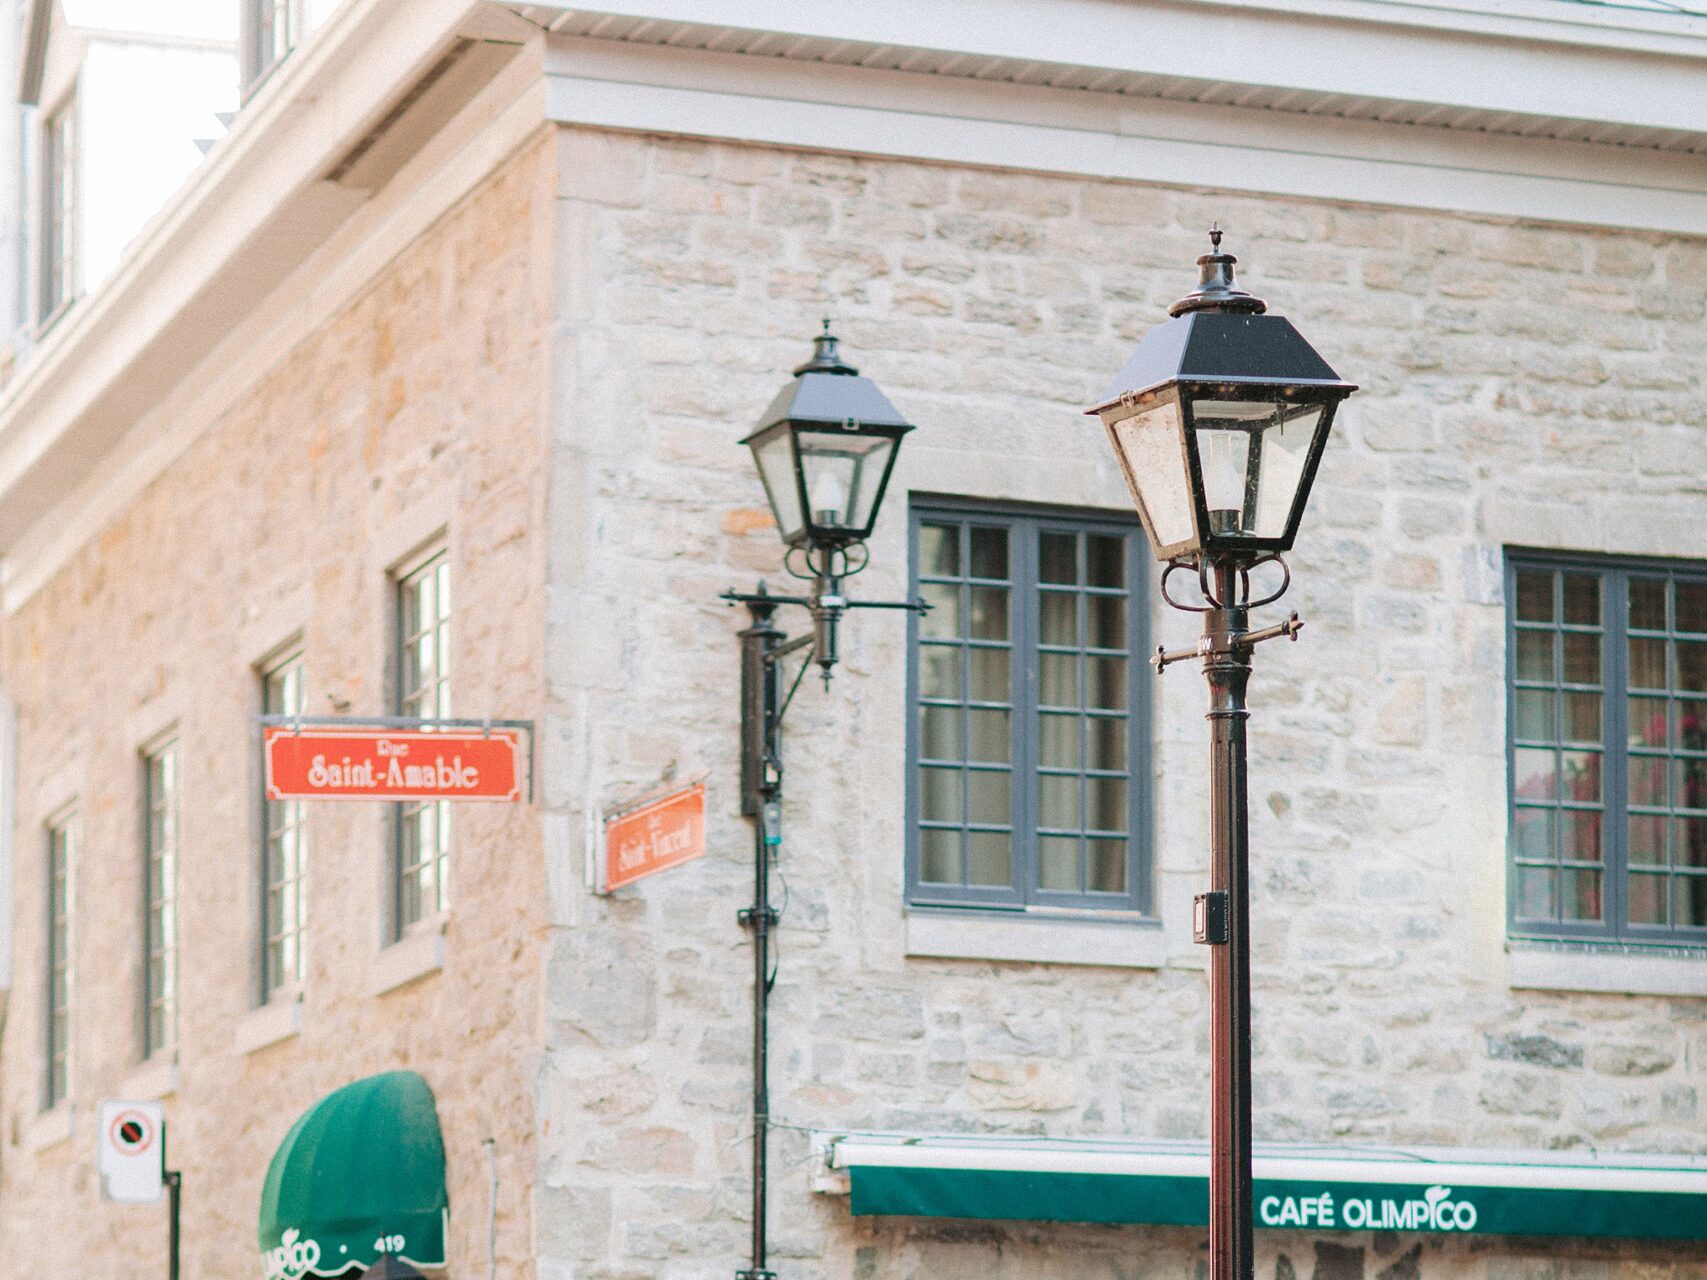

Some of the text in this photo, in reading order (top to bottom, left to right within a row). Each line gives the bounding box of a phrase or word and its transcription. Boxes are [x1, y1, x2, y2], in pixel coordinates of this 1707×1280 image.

[376, 738, 410, 757] Rue
[307, 754, 479, 789] Saint-Amable
[1260, 1186, 1478, 1231] CAFÉ OLIMPICO
[373, 1234, 406, 1253] 419
